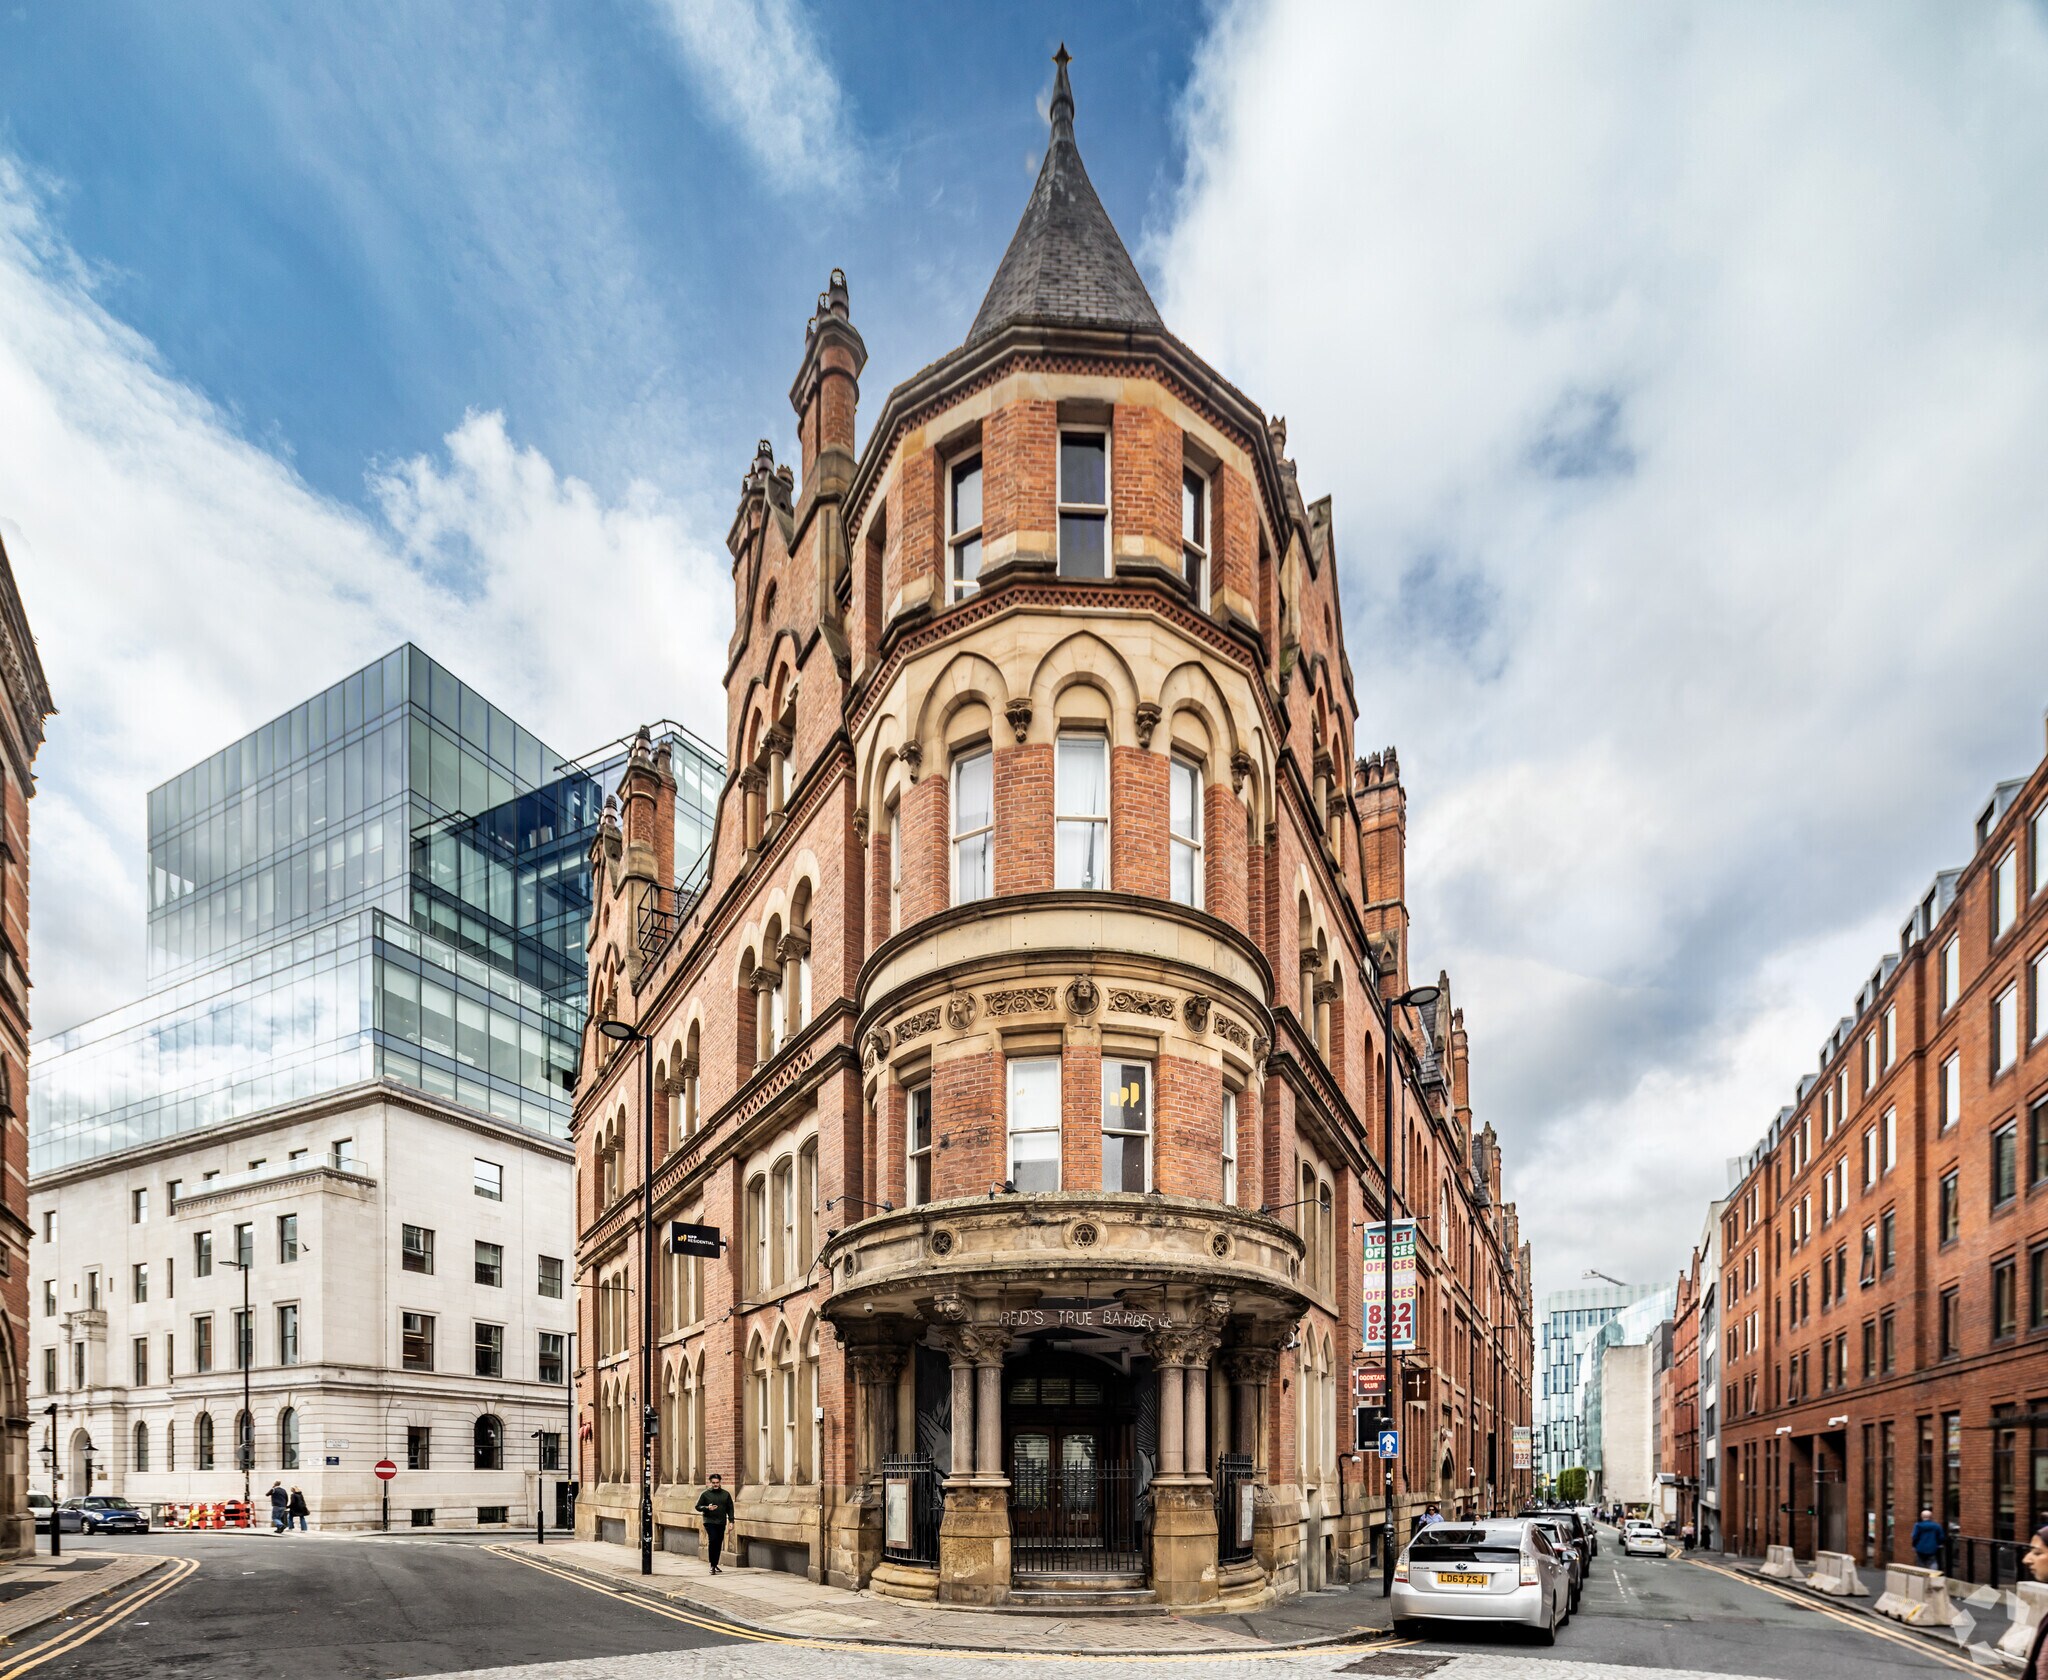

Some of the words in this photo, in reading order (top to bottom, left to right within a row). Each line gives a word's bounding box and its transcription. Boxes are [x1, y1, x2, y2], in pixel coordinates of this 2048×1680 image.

[1369, 1234, 1386, 1245] TO
[1392, 1231, 1412, 1243] ET
[1365, 1243, 1415, 1258] OFFCES
[1365, 1258, 1415, 1272] OFFCES
[1365, 1273, 1415, 1287] OFFCES
[1365, 1287, 1415, 1301] OFFCES
[1000, 1310, 1044, 1326] RED'S
[1058, 1310, 1093, 1326] TRUE
[1368, 1302, 1412, 1324] 832
[1367, 1323, 1412, 1341] 8321
[1440, 1574, 1464, 1583] LD63
[1466, 1575, 1485, 1585] ZSJ
